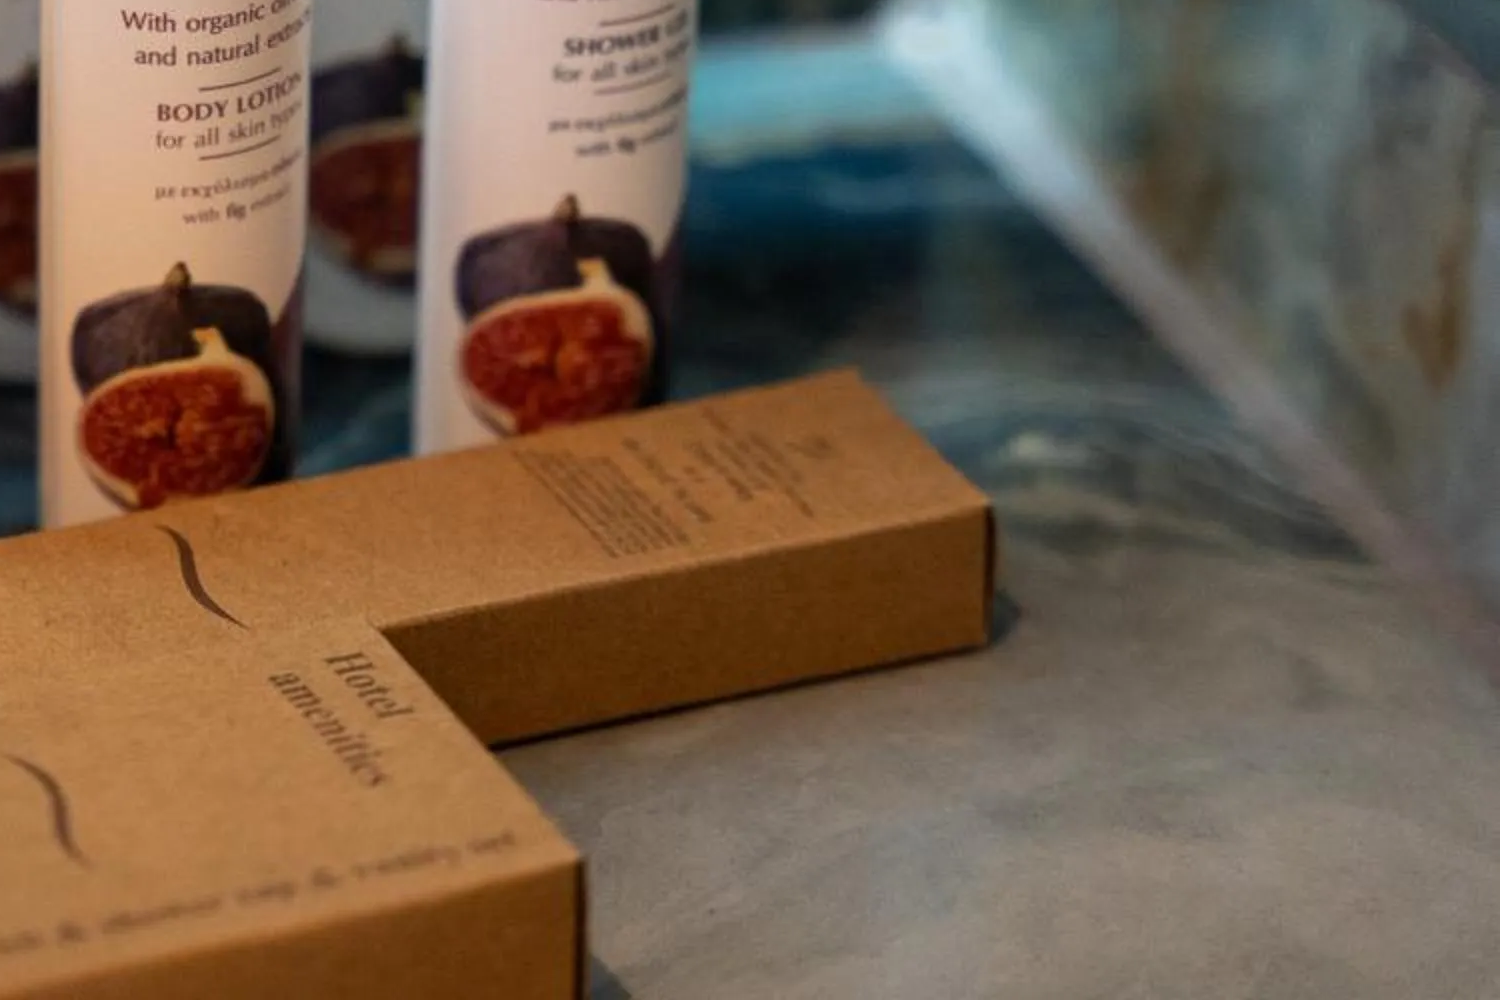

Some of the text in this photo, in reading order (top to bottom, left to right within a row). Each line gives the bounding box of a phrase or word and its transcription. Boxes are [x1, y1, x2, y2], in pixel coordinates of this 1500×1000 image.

[121, 9, 176, 33] With
[186, 2, 264, 35] organic
[134, 44, 177, 67] and
[187, 36, 259, 66] natural
[157, 104, 228, 123] BODY
[156, 131, 184, 150] for
[195, 127, 219, 149] all
[228, 119, 265, 142] skin
[323, 652, 414, 719] Hotel
